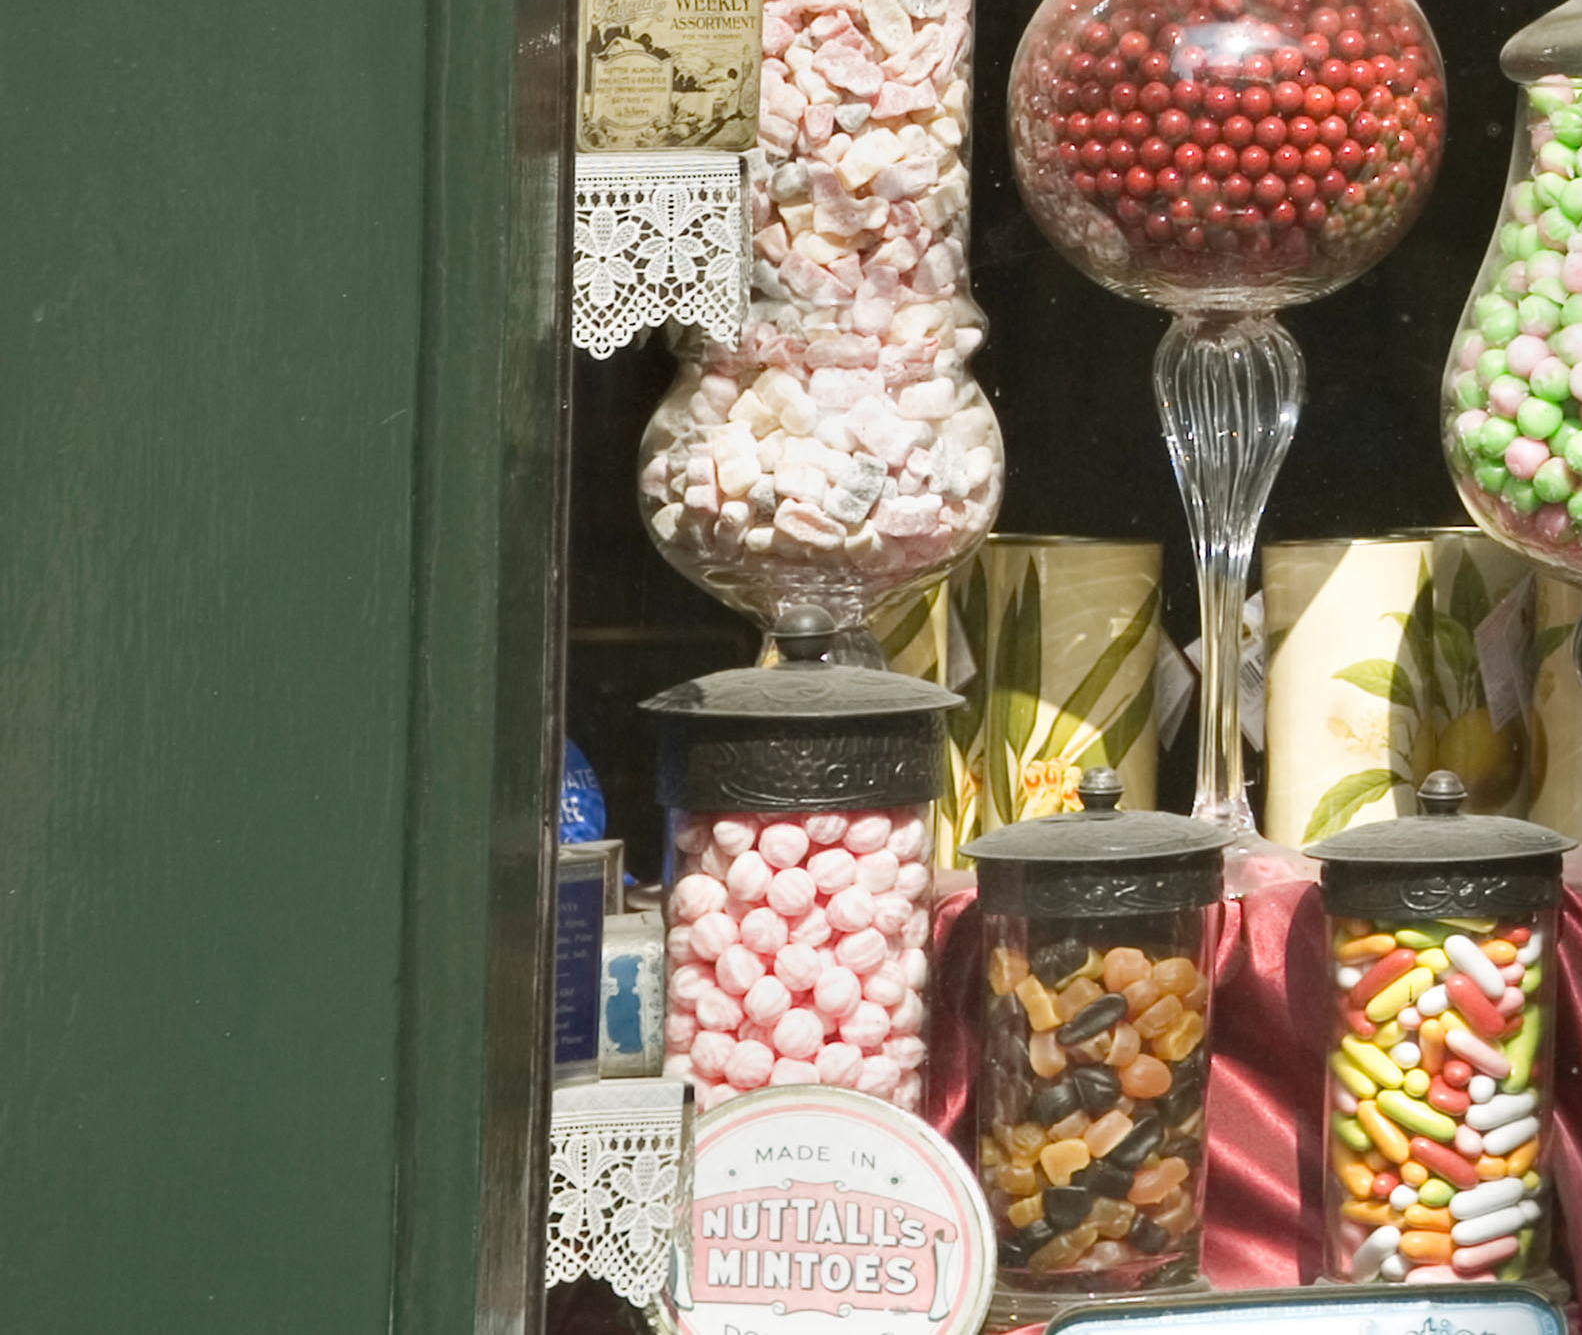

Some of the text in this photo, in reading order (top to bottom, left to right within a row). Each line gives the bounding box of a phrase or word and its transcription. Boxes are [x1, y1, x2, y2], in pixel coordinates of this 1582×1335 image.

[671, 16, 756, 30] ASSORTMENT
[755, 1145, 876, 1169] MADE IN
[702, 1198, 927, 1249] NUTTALL'S
[707, 1248, 917, 1295] MINTOES
